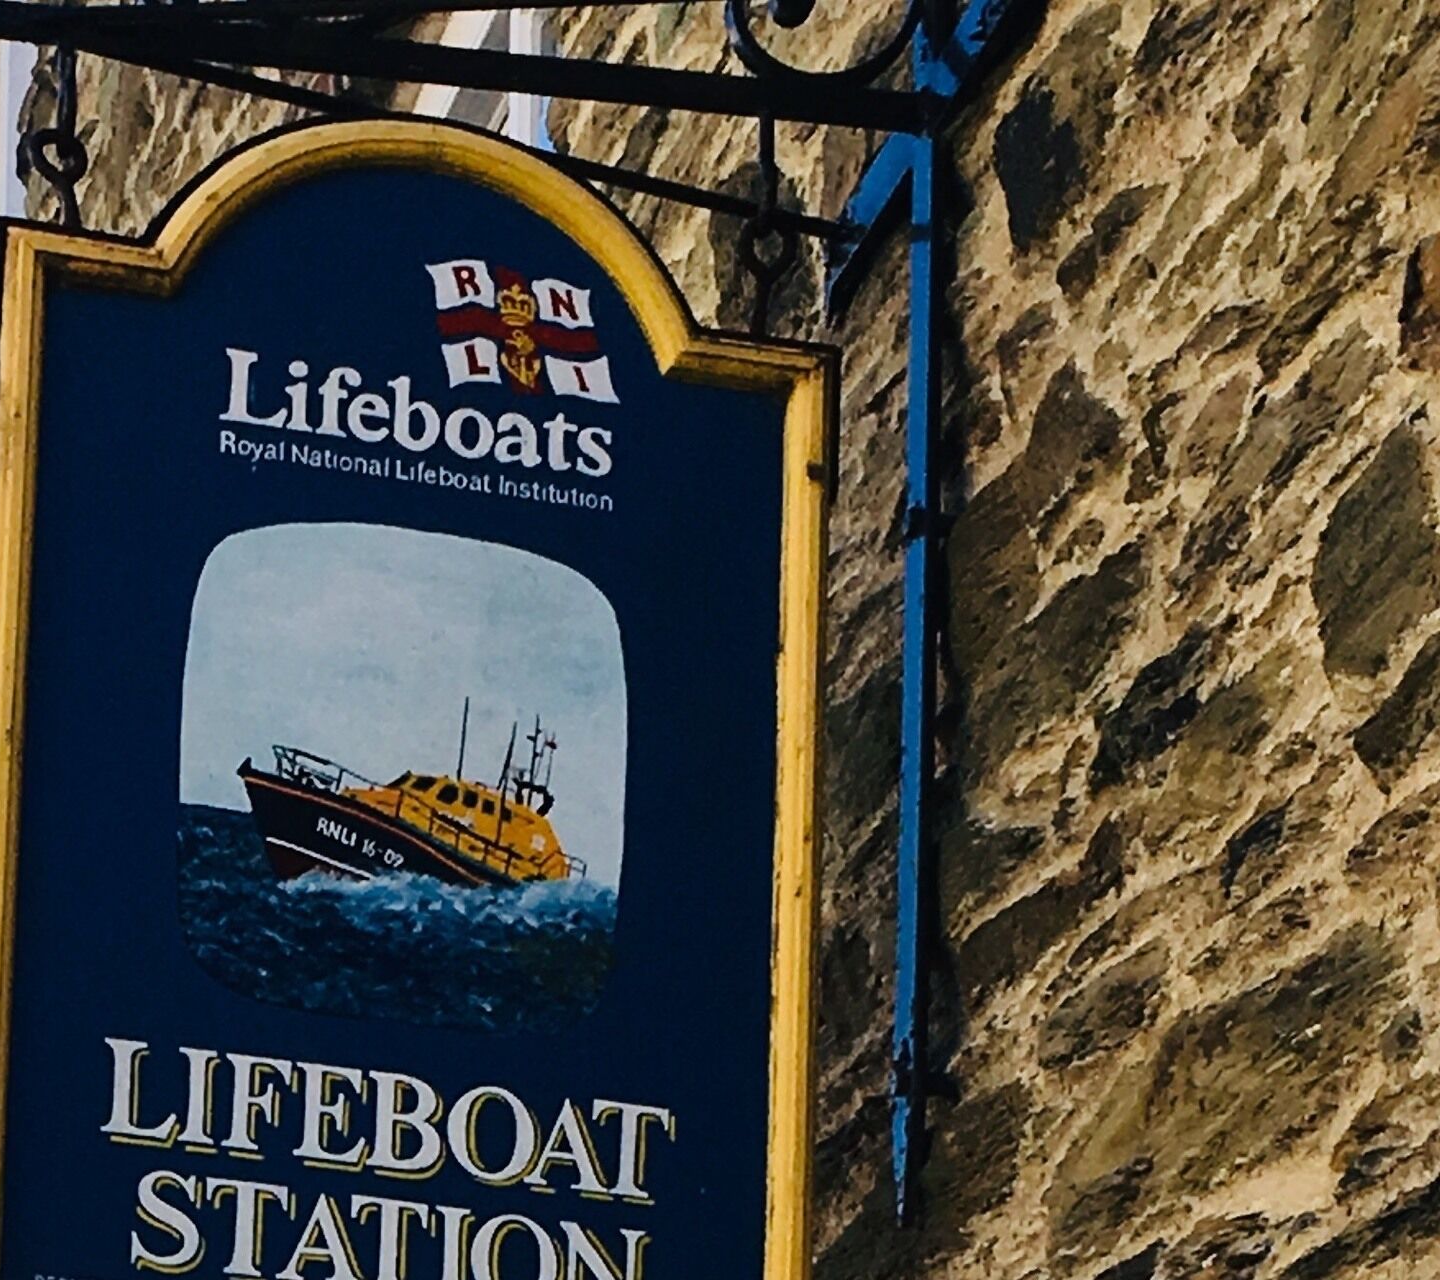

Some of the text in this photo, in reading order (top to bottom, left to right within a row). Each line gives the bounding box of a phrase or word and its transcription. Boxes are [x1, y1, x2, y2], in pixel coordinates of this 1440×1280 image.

[452, 266, 579, 320] R N
[464, 344, 490, 375] L
[218, 347, 612, 477] Lifeboats
[219, 430, 613, 511] Royal National Lifeboat Institution
[316, 817, 357, 847] RNLI
[100, 1037, 672, 1202] LIFEBOAT
